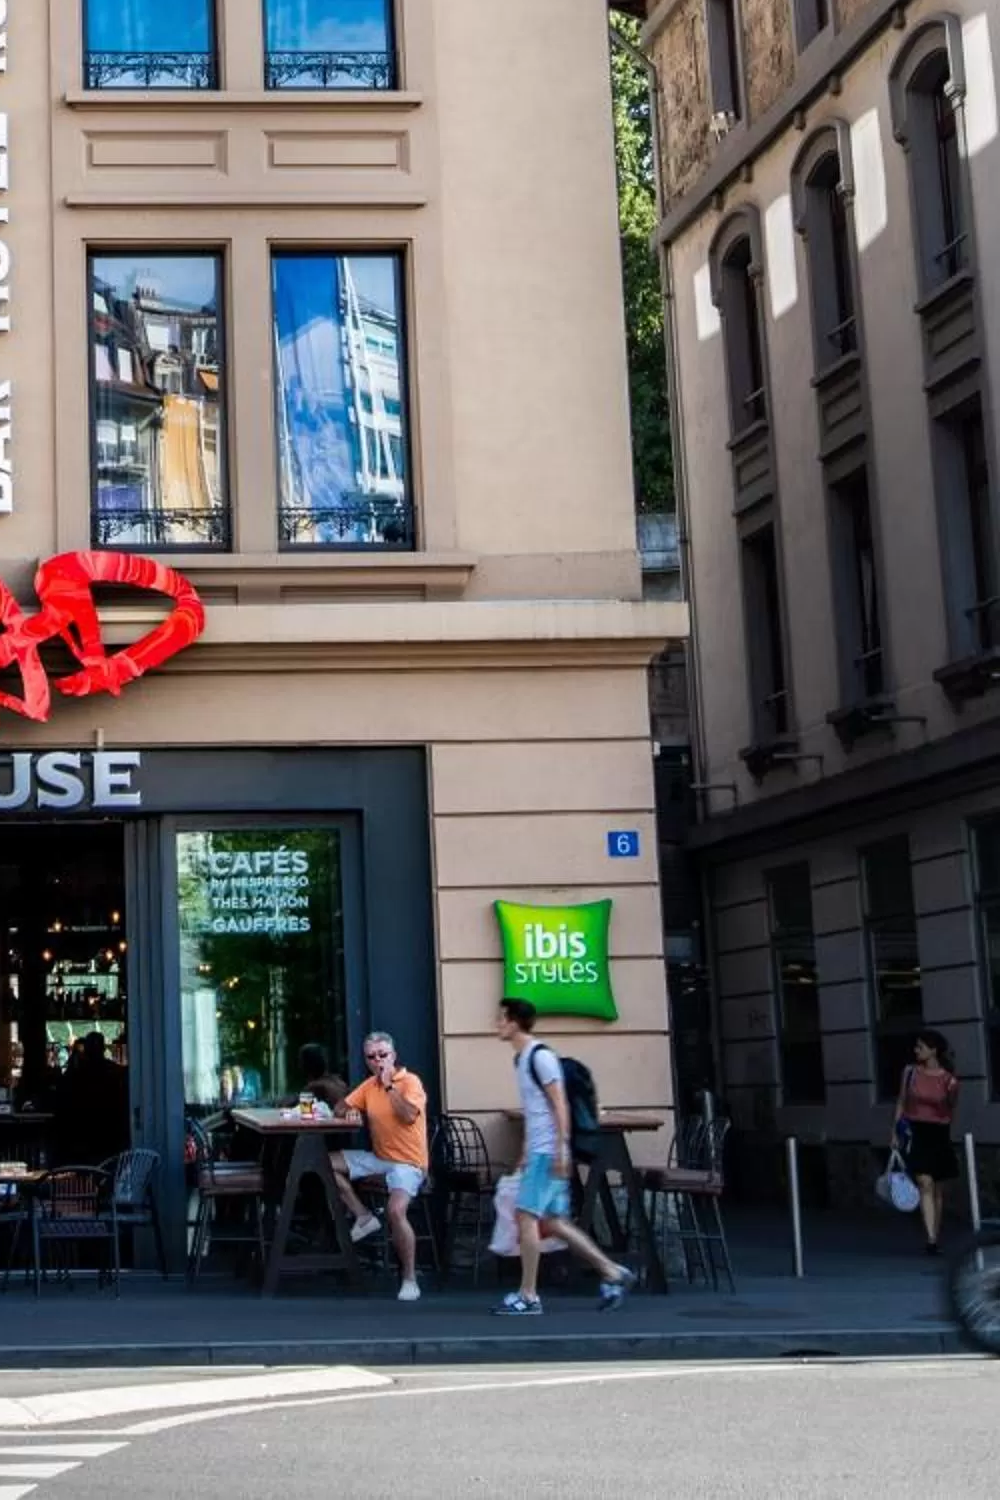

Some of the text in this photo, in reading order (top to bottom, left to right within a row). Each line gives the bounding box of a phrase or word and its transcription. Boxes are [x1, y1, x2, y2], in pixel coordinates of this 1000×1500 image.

[616, 833, 631, 855] 6
[208, 845, 310, 875] CAFÉS
[231, 876, 310, 888] NESPRESSO
[212, 915, 312, 933] GAUFFRES
[524, 923, 588, 960] ibis
